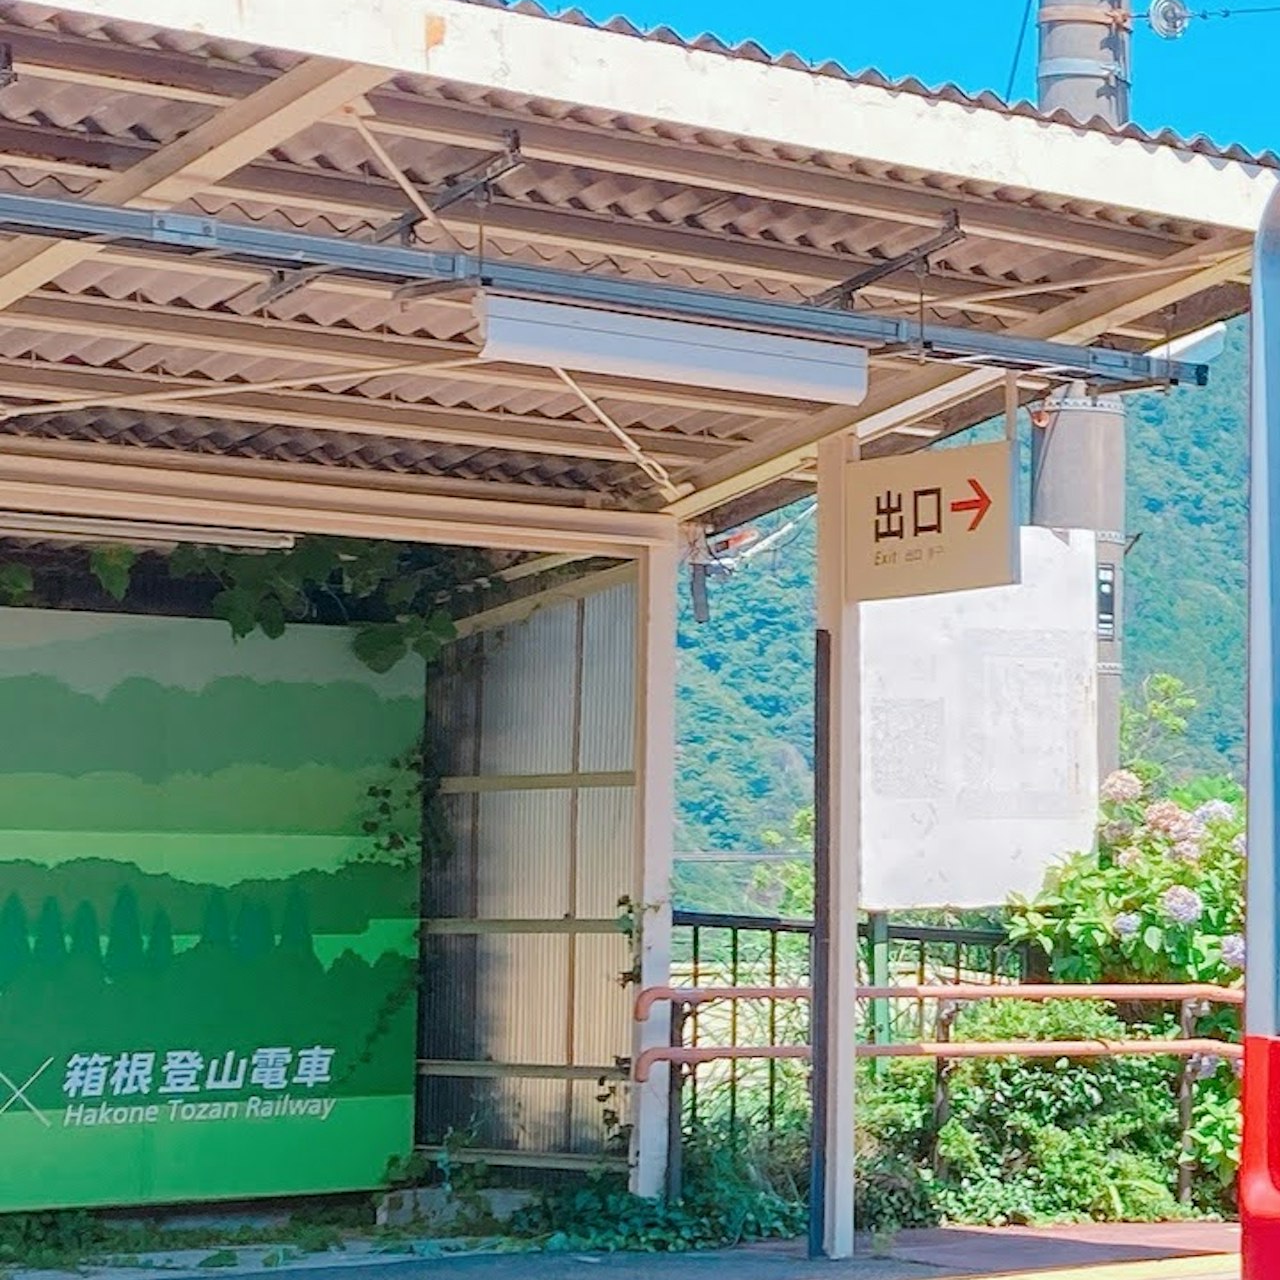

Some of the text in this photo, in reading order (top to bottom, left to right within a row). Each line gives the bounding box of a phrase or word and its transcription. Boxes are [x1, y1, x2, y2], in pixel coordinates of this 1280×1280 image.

[874, 487, 942, 543] 出口
[874, 551, 897, 566] Exit
[63, 1046, 336, 1098] 箱根登山電車
[64, 1093, 337, 1127] Hakone Tozan Railway
